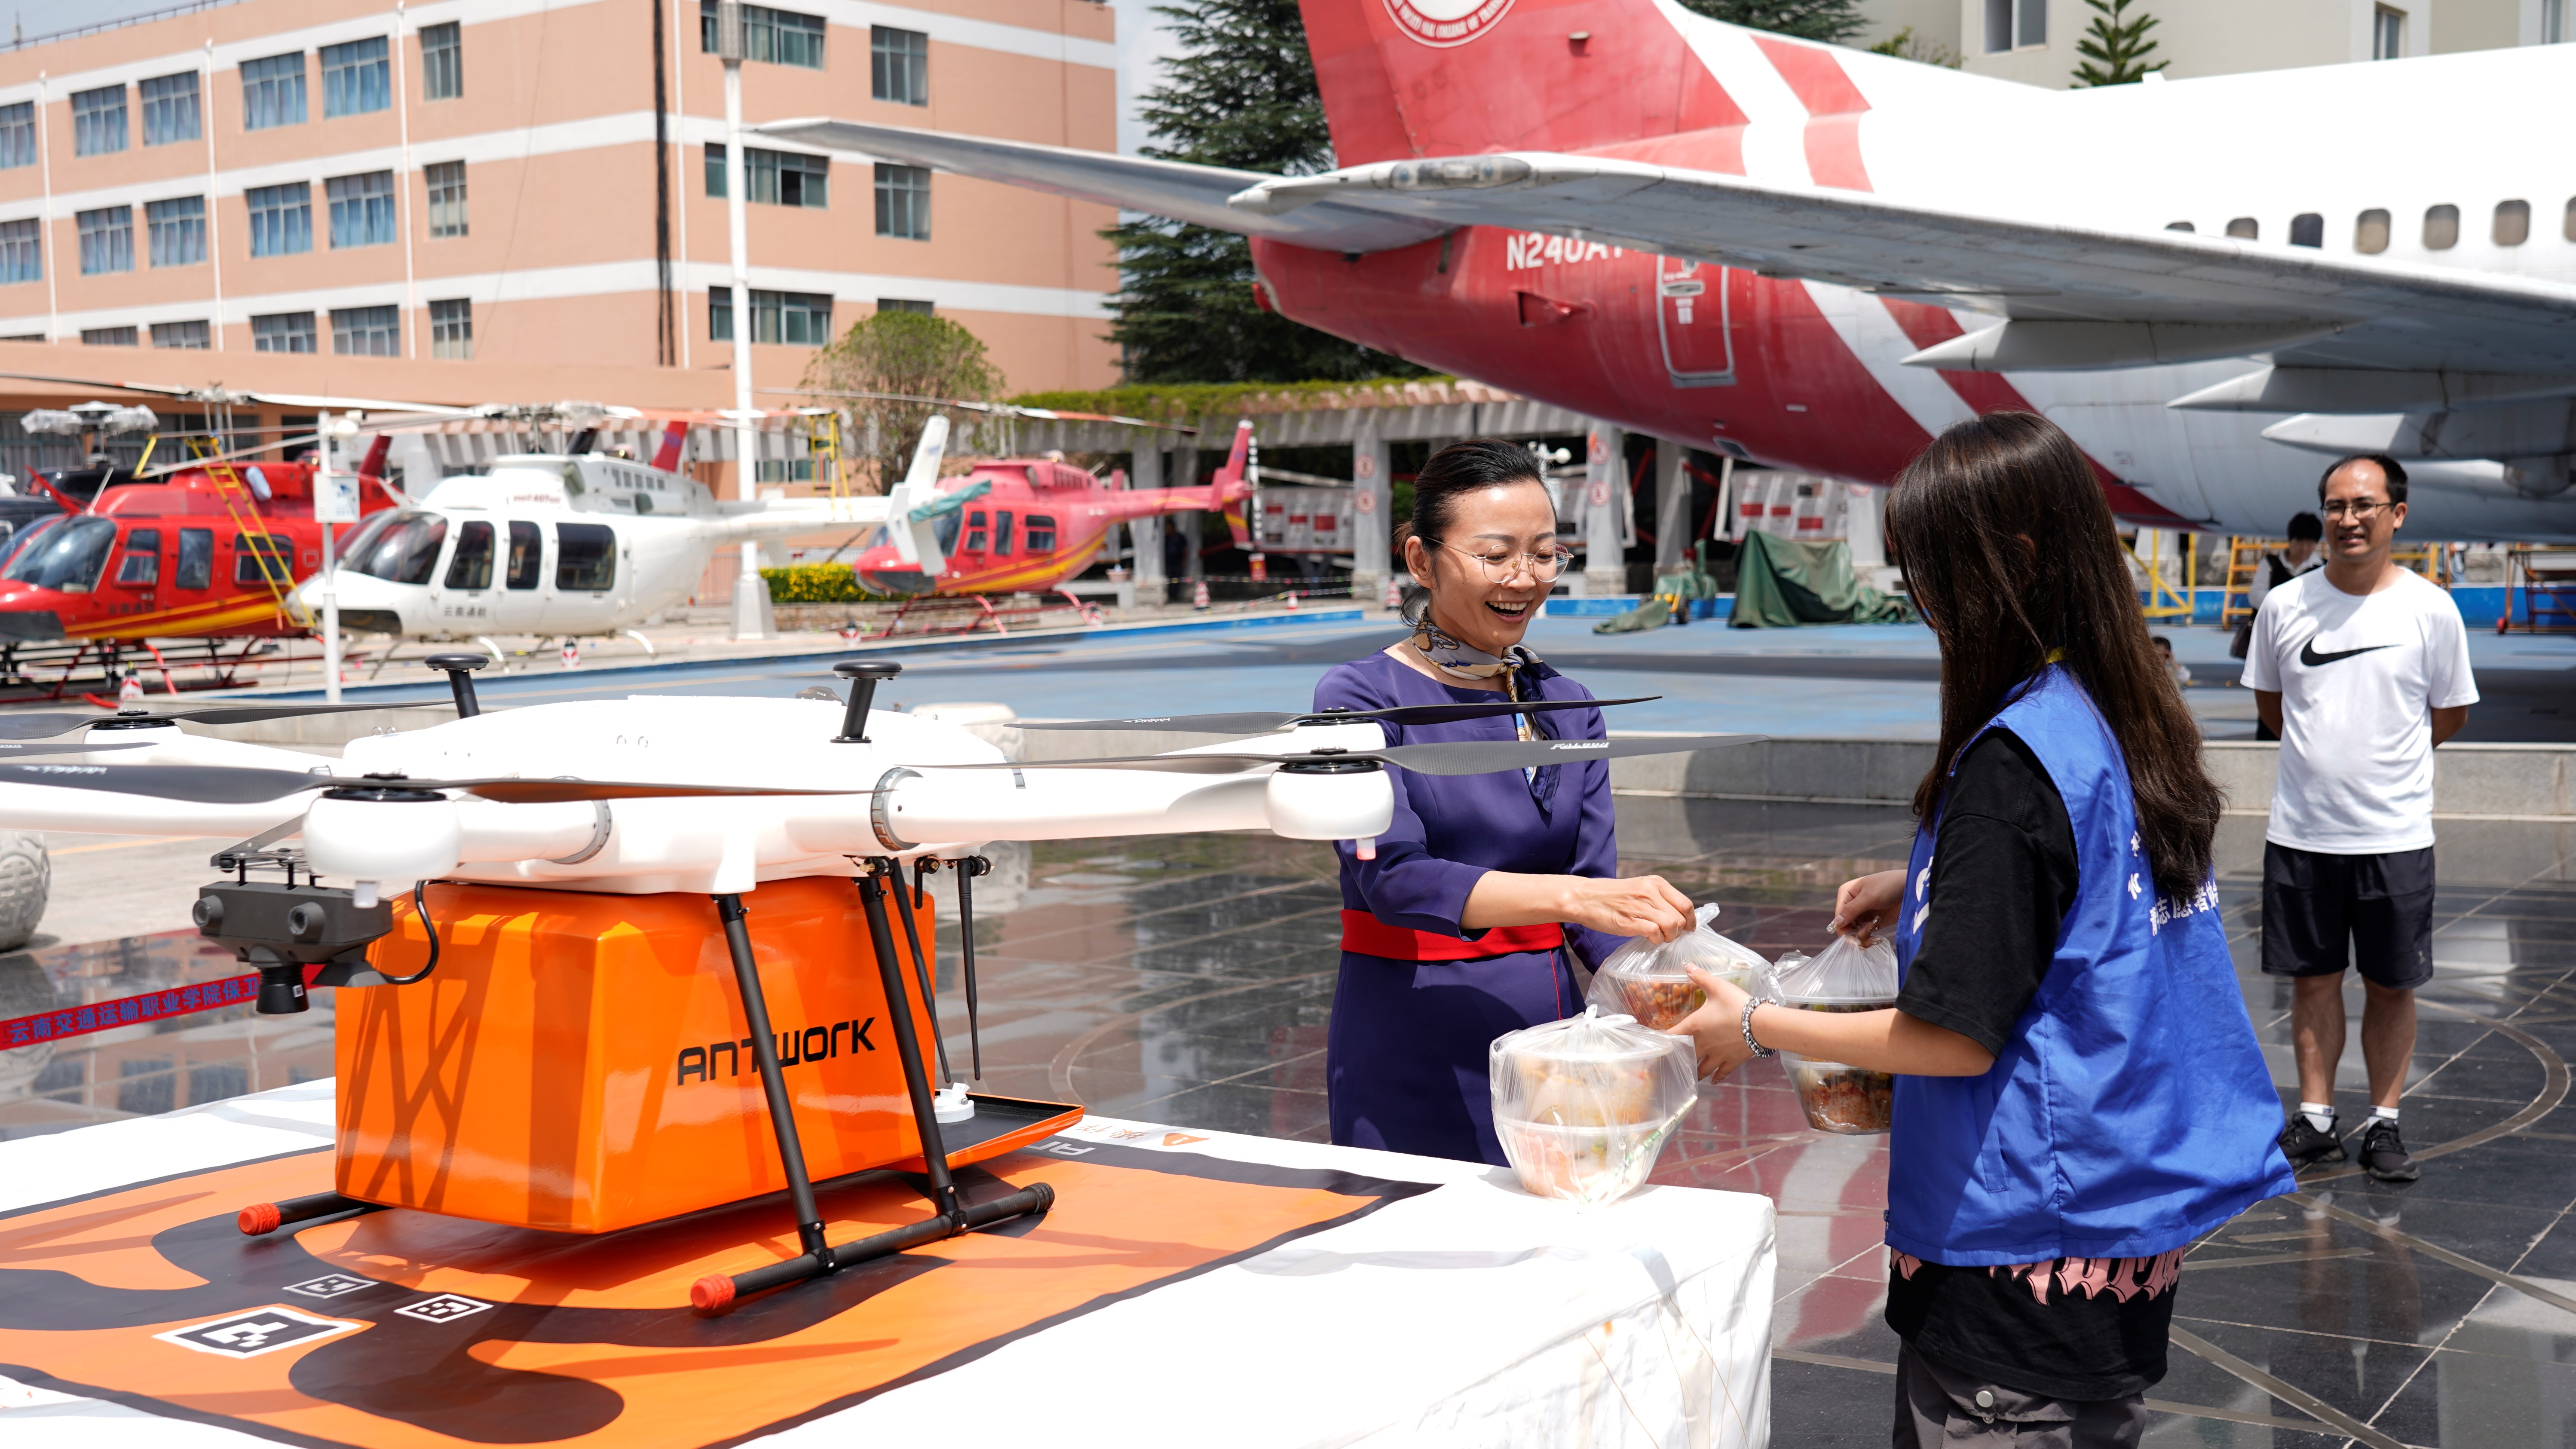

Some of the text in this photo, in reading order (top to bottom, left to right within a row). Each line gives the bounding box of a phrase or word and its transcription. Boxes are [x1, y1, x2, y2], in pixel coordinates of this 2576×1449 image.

[9, 977, 258, 1043] 云南交通运输职业学院保卫
